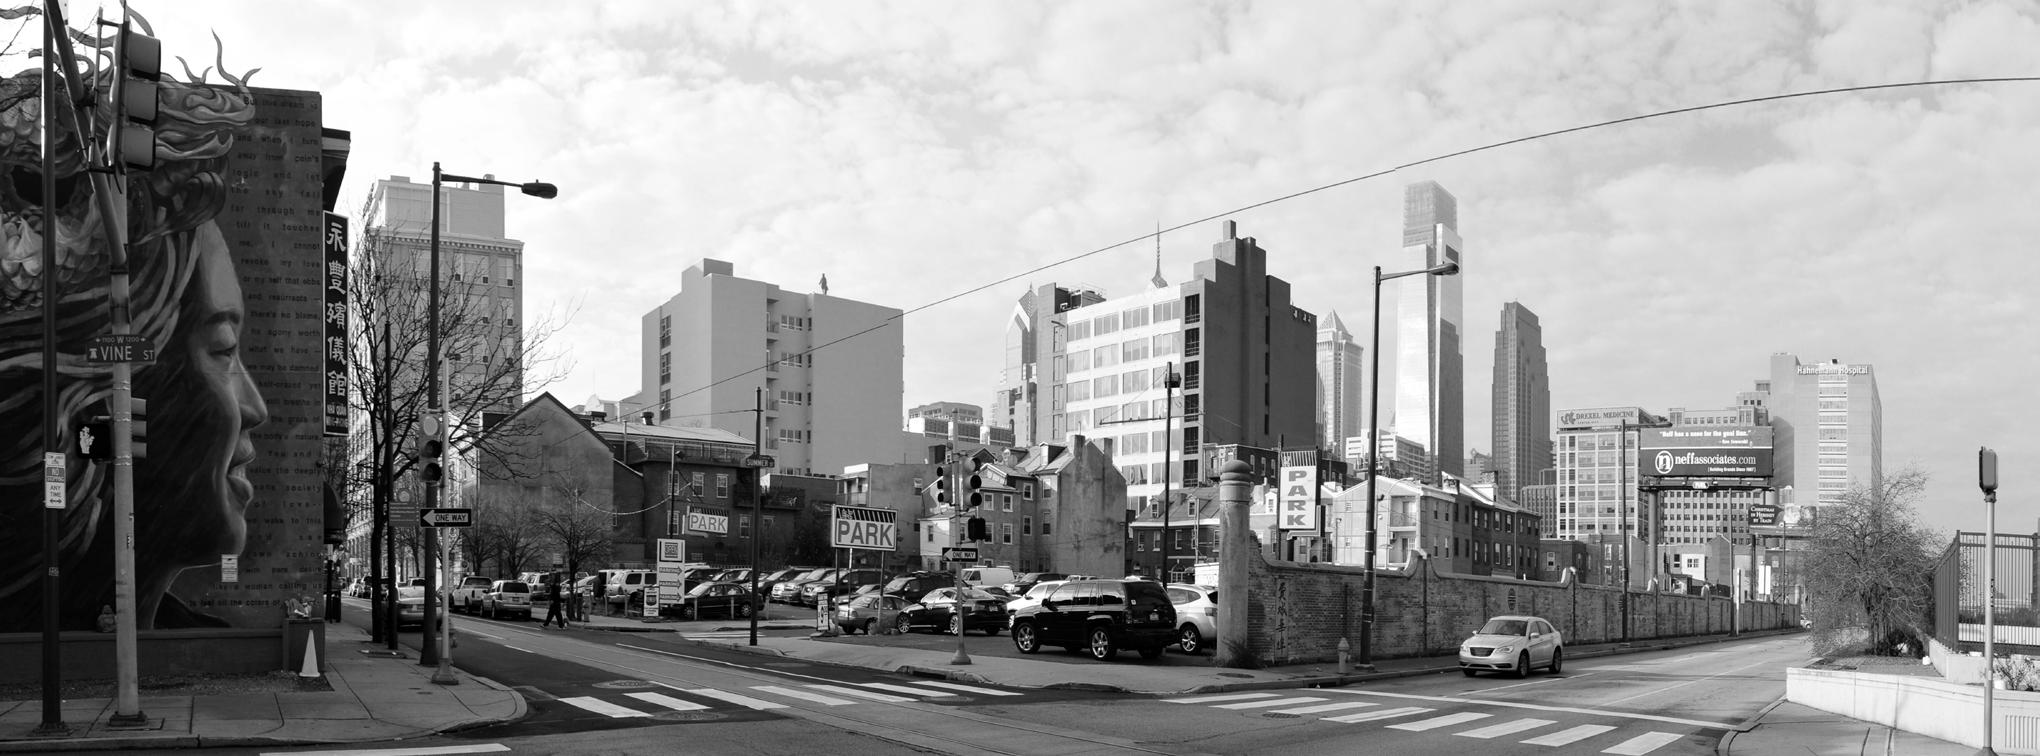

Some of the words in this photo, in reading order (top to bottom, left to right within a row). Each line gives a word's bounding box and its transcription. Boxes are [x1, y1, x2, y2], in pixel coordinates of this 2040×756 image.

[100, 346, 132, 360] VINE
[143, 350, 154, 360] ST
[1840, 365, 1868, 376] Hospital
[1576, 412, 1601, 420] DREXEL
[746, 458, 768, 467] SUMMER
[1675, 452, 1756, 465] neffassociates.com
[1287, 470, 1308, 526] PARK
[691, 514, 726, 531] PARK
[838, 520, 893, 546] PARK
